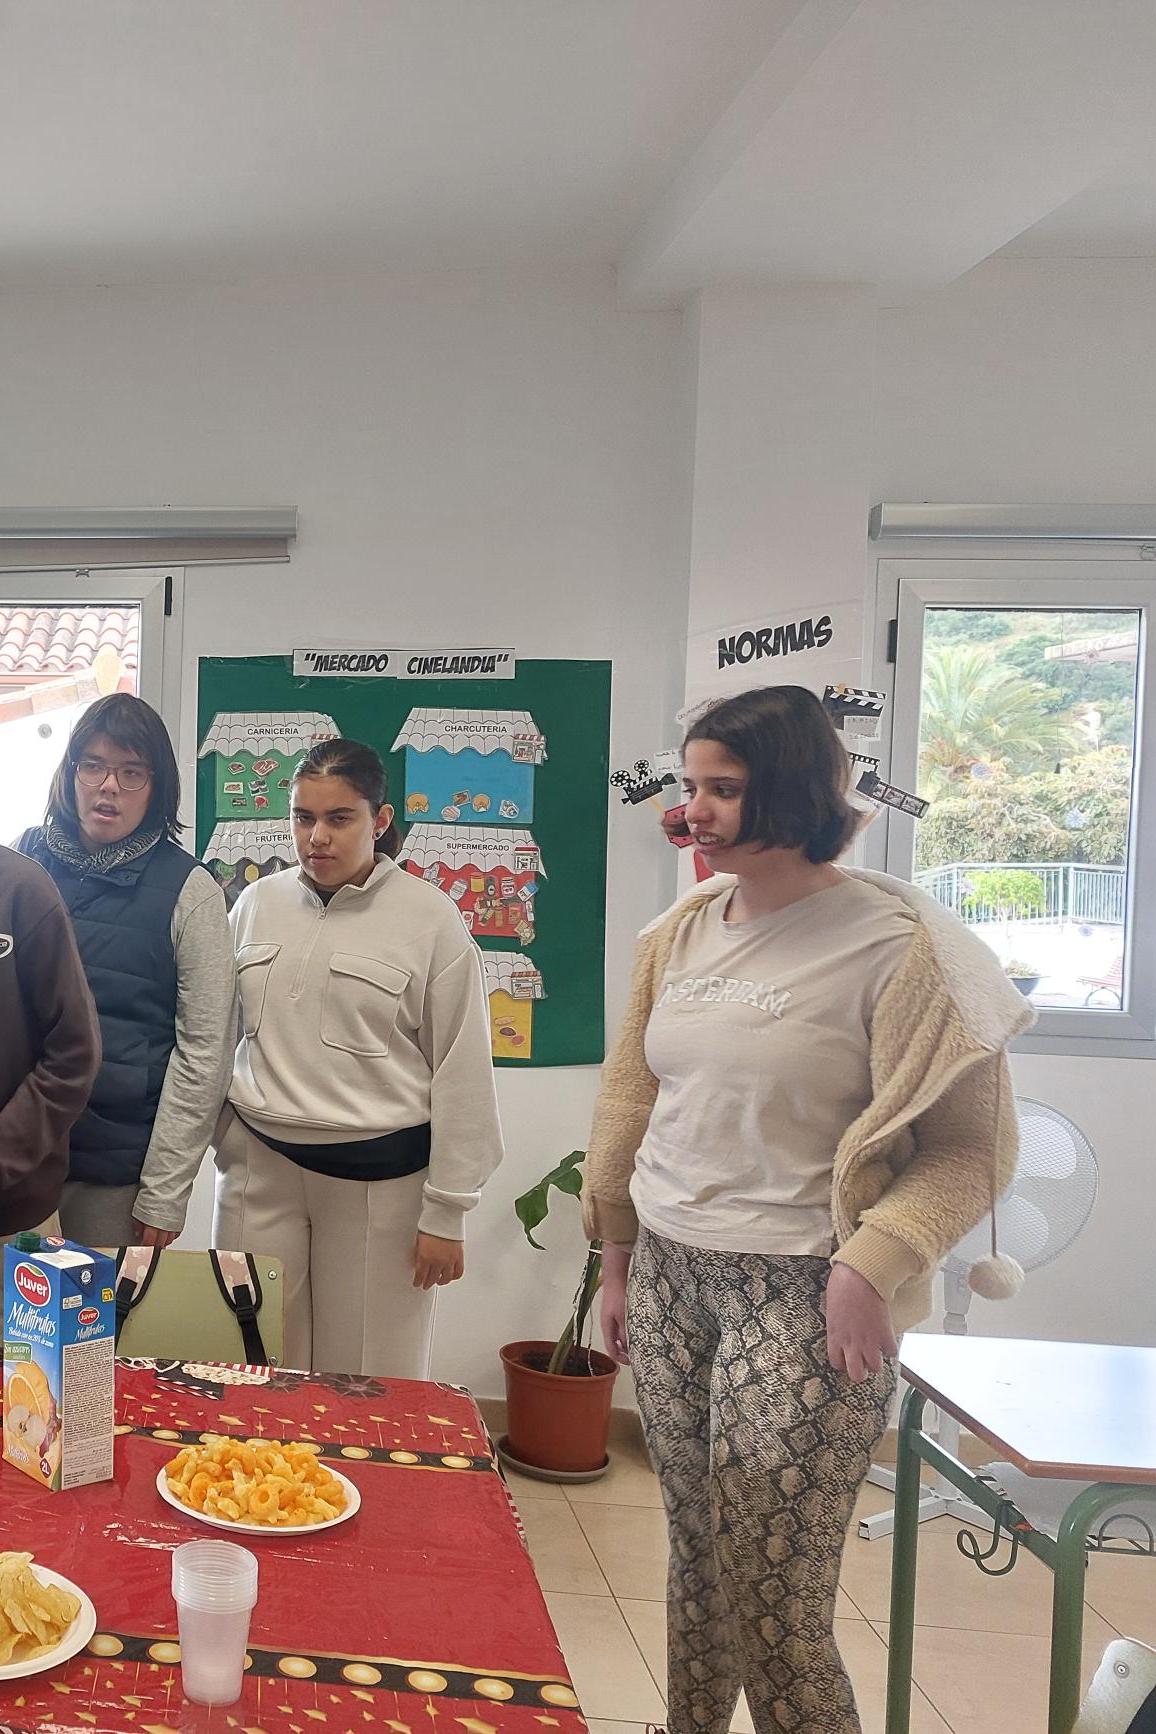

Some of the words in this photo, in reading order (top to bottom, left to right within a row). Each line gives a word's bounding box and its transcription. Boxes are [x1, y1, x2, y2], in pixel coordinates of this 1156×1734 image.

[718, 615, 833, 670] NORMAS
[247, 726, 300, 736] CARNICERIA
[444, 724, 508, 734] CHARCUTERIA
[446, 842, 510, 852] SUPERMERCADO
[18, 1272, 48, 1297] Juver
[7, 1302, 56, 1337] Multifrutas
[80, 1311, 97, 1321] Juver
[75, 1323, 105, 1342] Multifrutas
[41, 1461, 50, 1475] 2L
